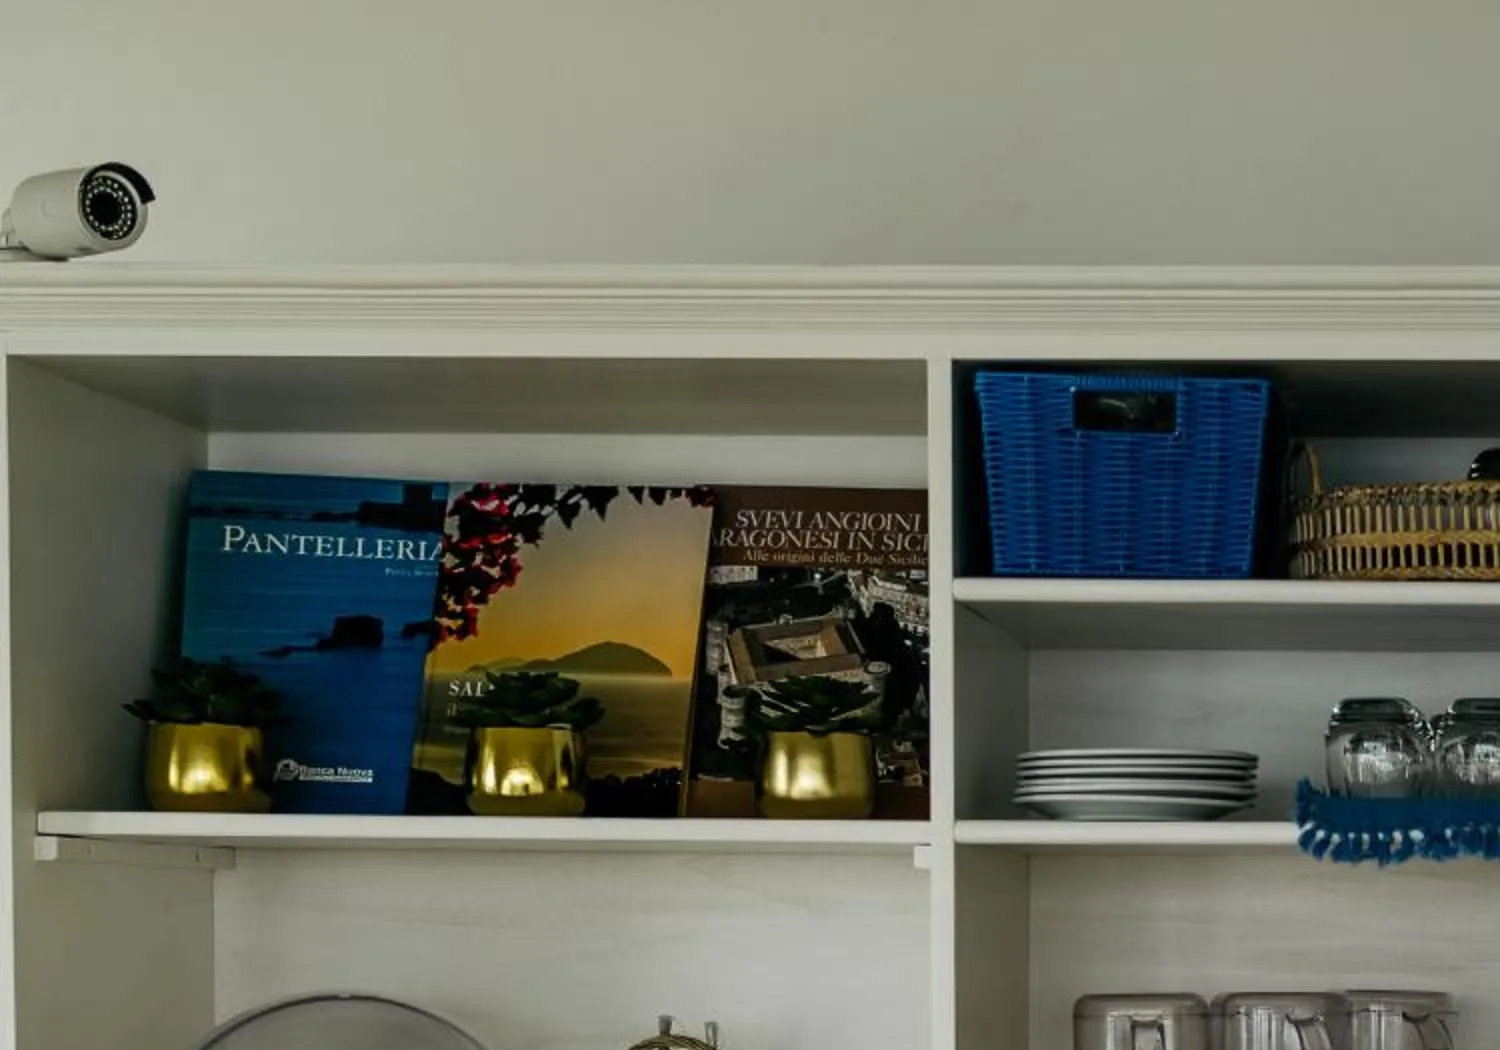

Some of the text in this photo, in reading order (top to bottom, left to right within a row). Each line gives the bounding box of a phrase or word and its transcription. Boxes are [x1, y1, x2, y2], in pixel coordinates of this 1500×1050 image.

[735, 508, 921, 532] SVEVI ANGIOINI
[847, 531, 877, 551] IN
[819, 551, 852, 564] delle
[856, 551, 884, 565] Due
